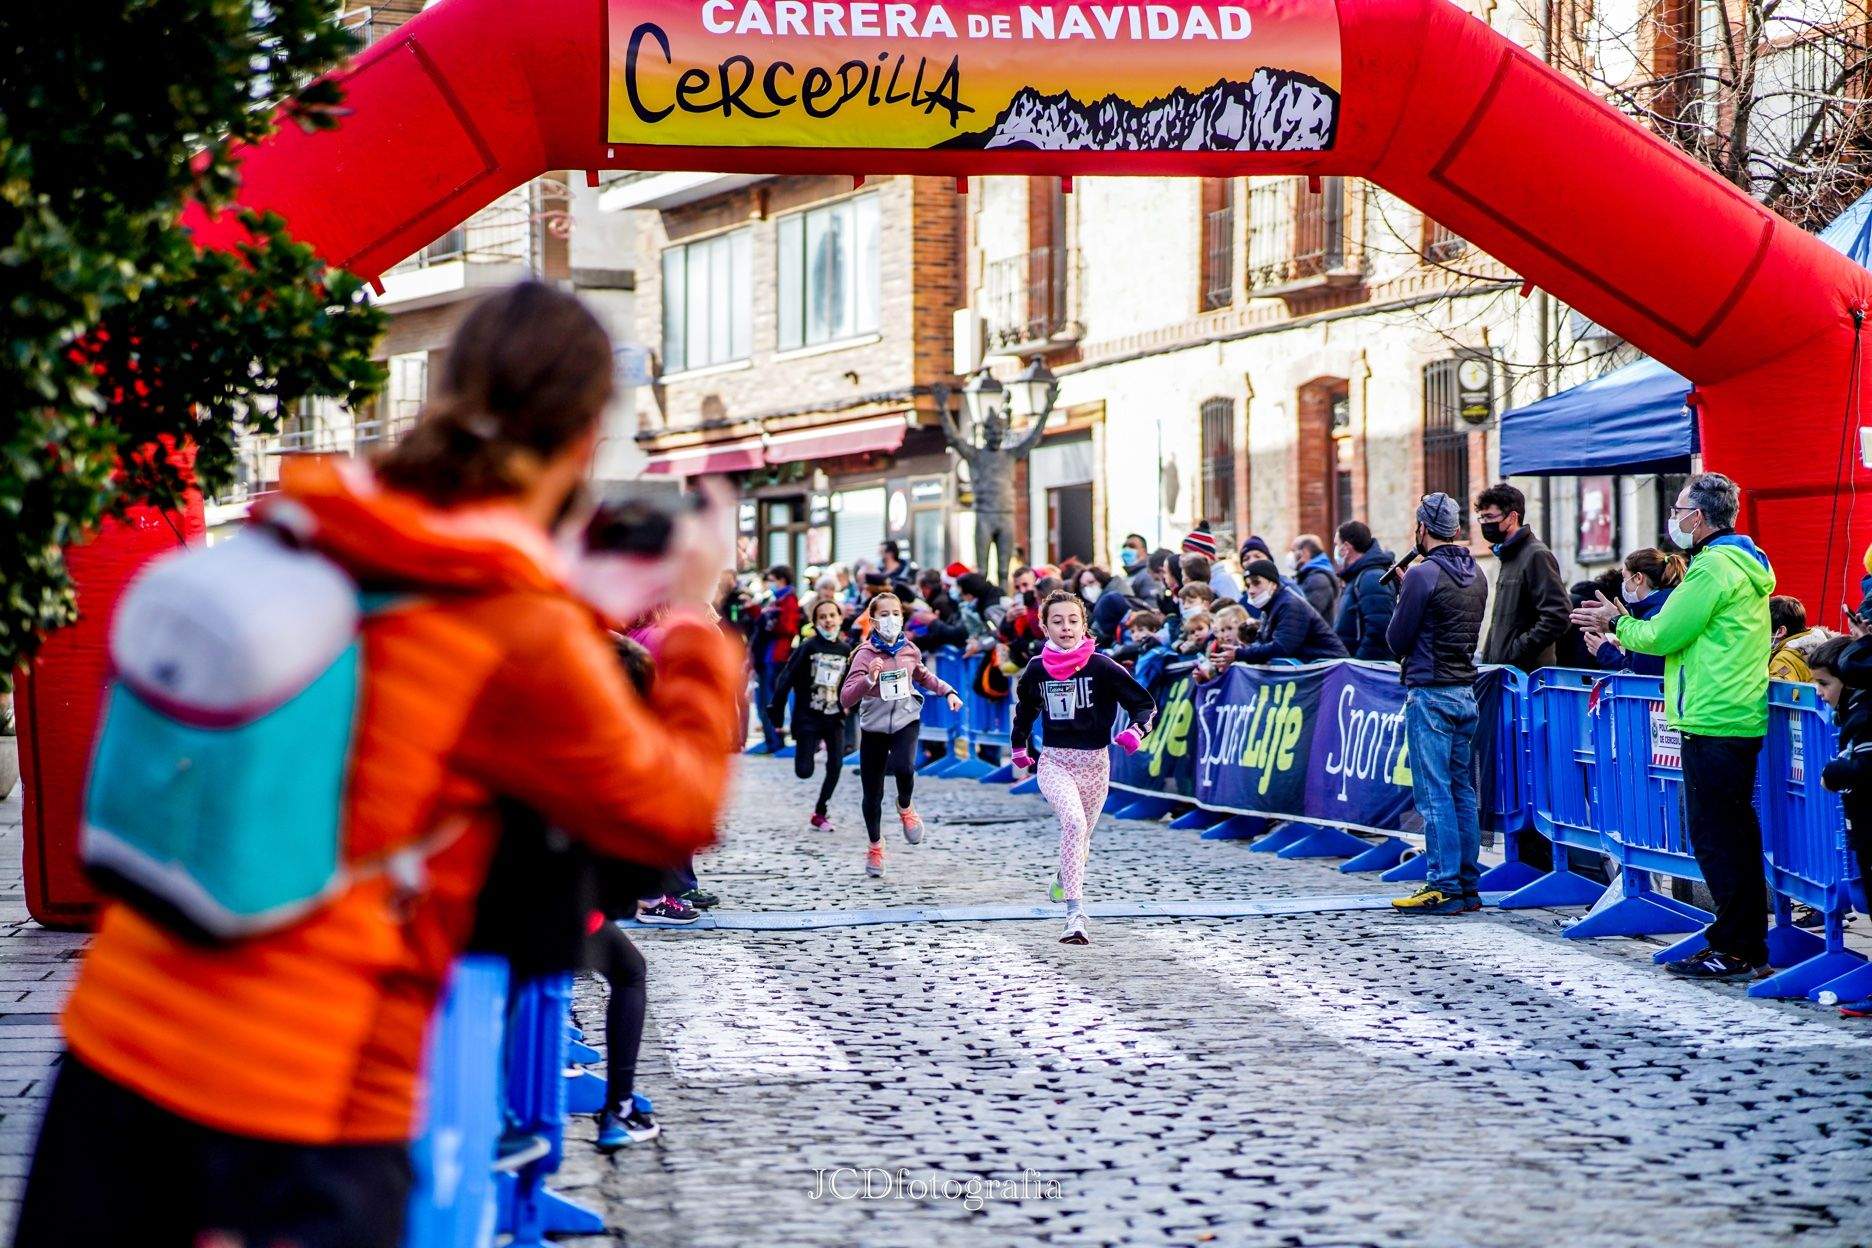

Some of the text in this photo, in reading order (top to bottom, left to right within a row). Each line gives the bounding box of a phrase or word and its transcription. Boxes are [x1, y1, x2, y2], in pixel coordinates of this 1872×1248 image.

[702, 1, 1252, 39] CARRERA DE NAVIDAD
[893, 684, 898, 694] 1
[1060, 698, 1067, 712] 1
